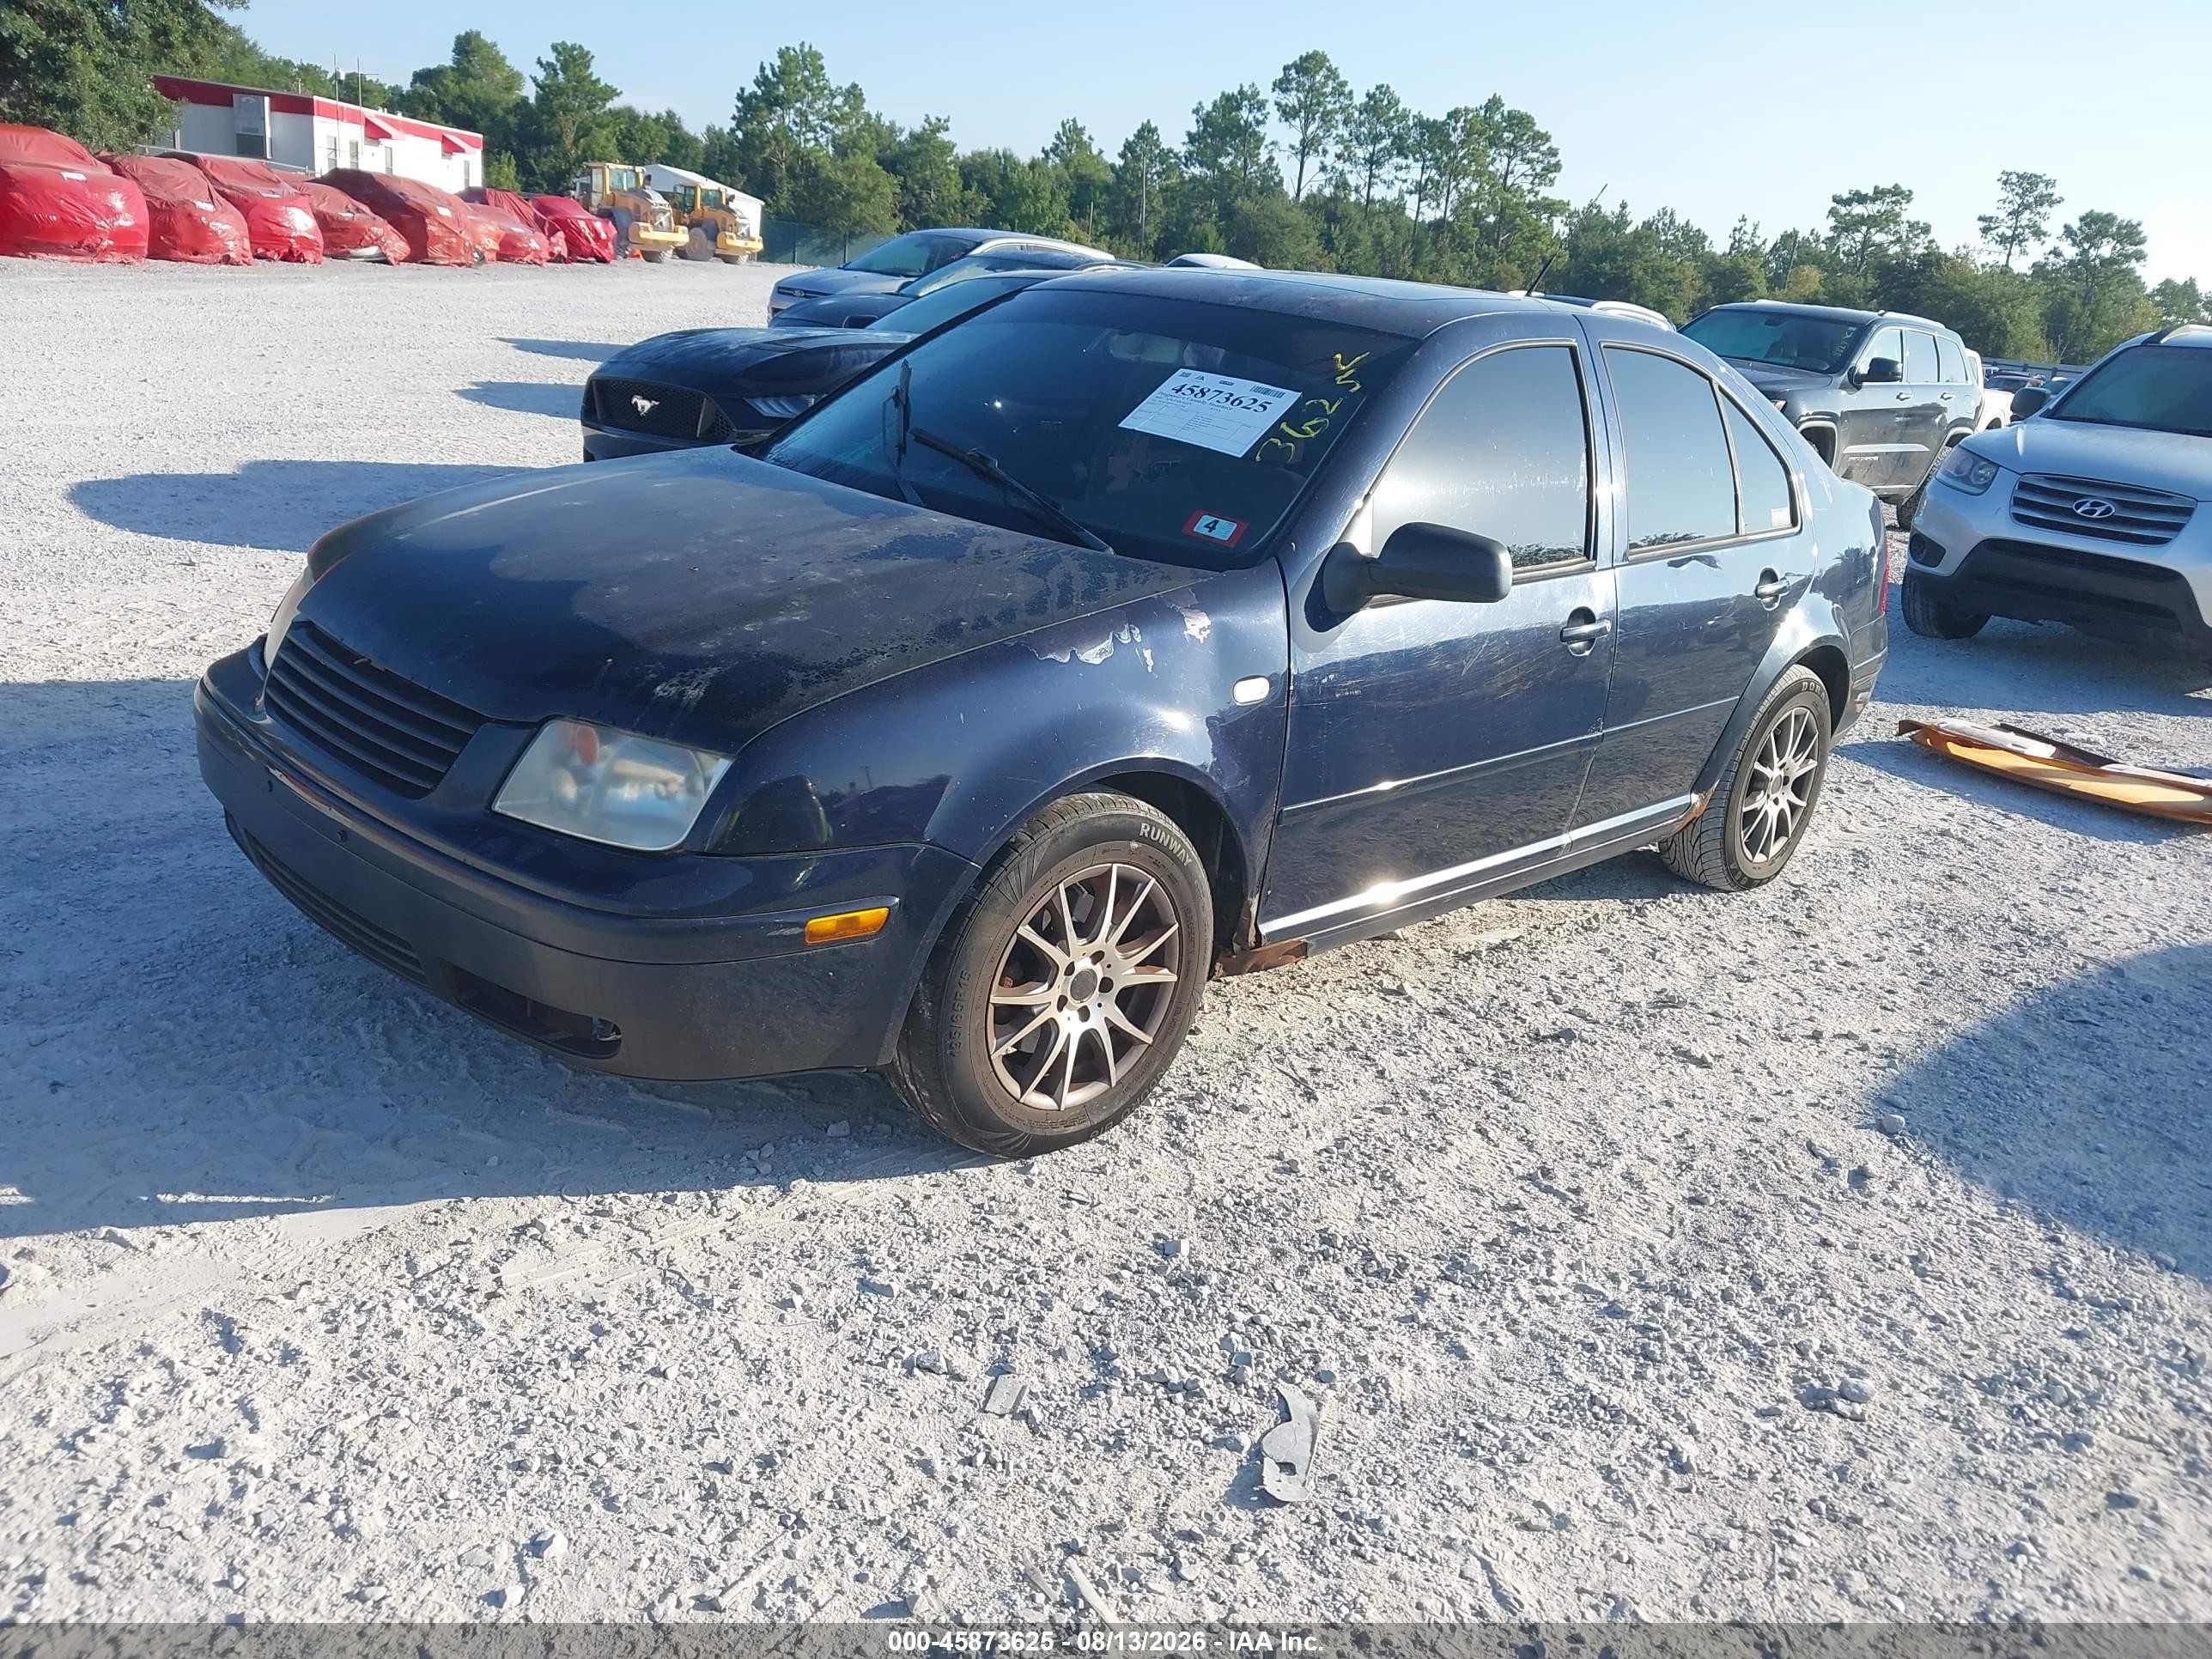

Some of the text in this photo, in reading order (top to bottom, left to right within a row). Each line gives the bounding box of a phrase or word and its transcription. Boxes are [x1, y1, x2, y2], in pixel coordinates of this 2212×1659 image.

[1170, 382, 1274, 413] 45873625
[1203, 519, 1220, 533] 4
[1139, 822, 1193, 866] RUNWAY
